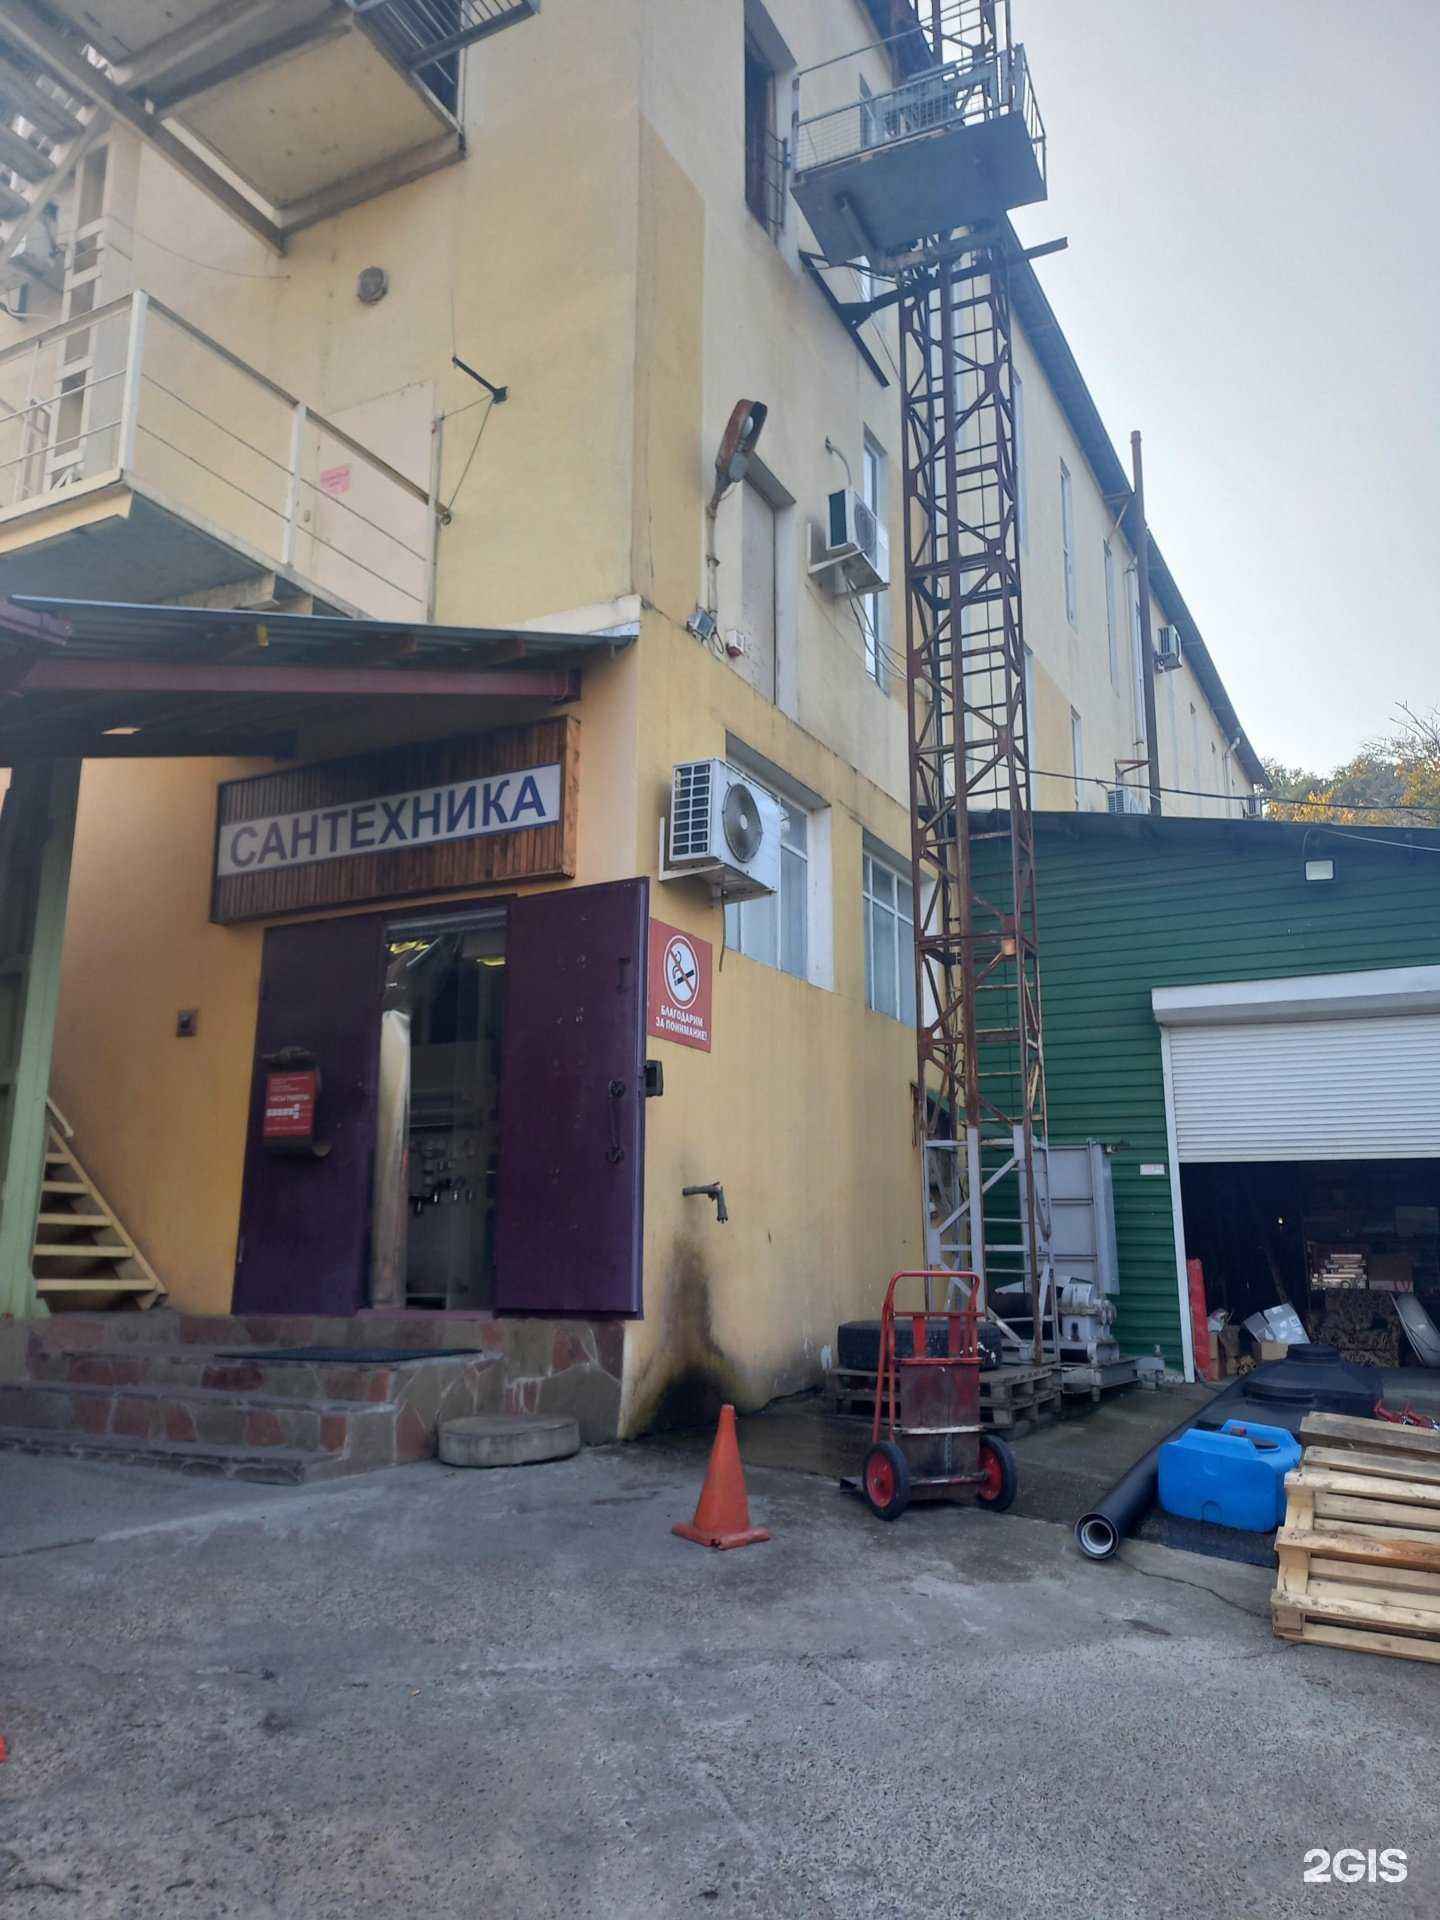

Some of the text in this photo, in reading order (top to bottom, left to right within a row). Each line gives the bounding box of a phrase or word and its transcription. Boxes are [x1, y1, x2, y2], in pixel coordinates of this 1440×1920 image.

[229, 774, 547, 868] САНТЕХНИКА
[655, 1016, 665, 1029] ЗА
[660, 1004, 704, 1027] БЛАГОДАРИМ
